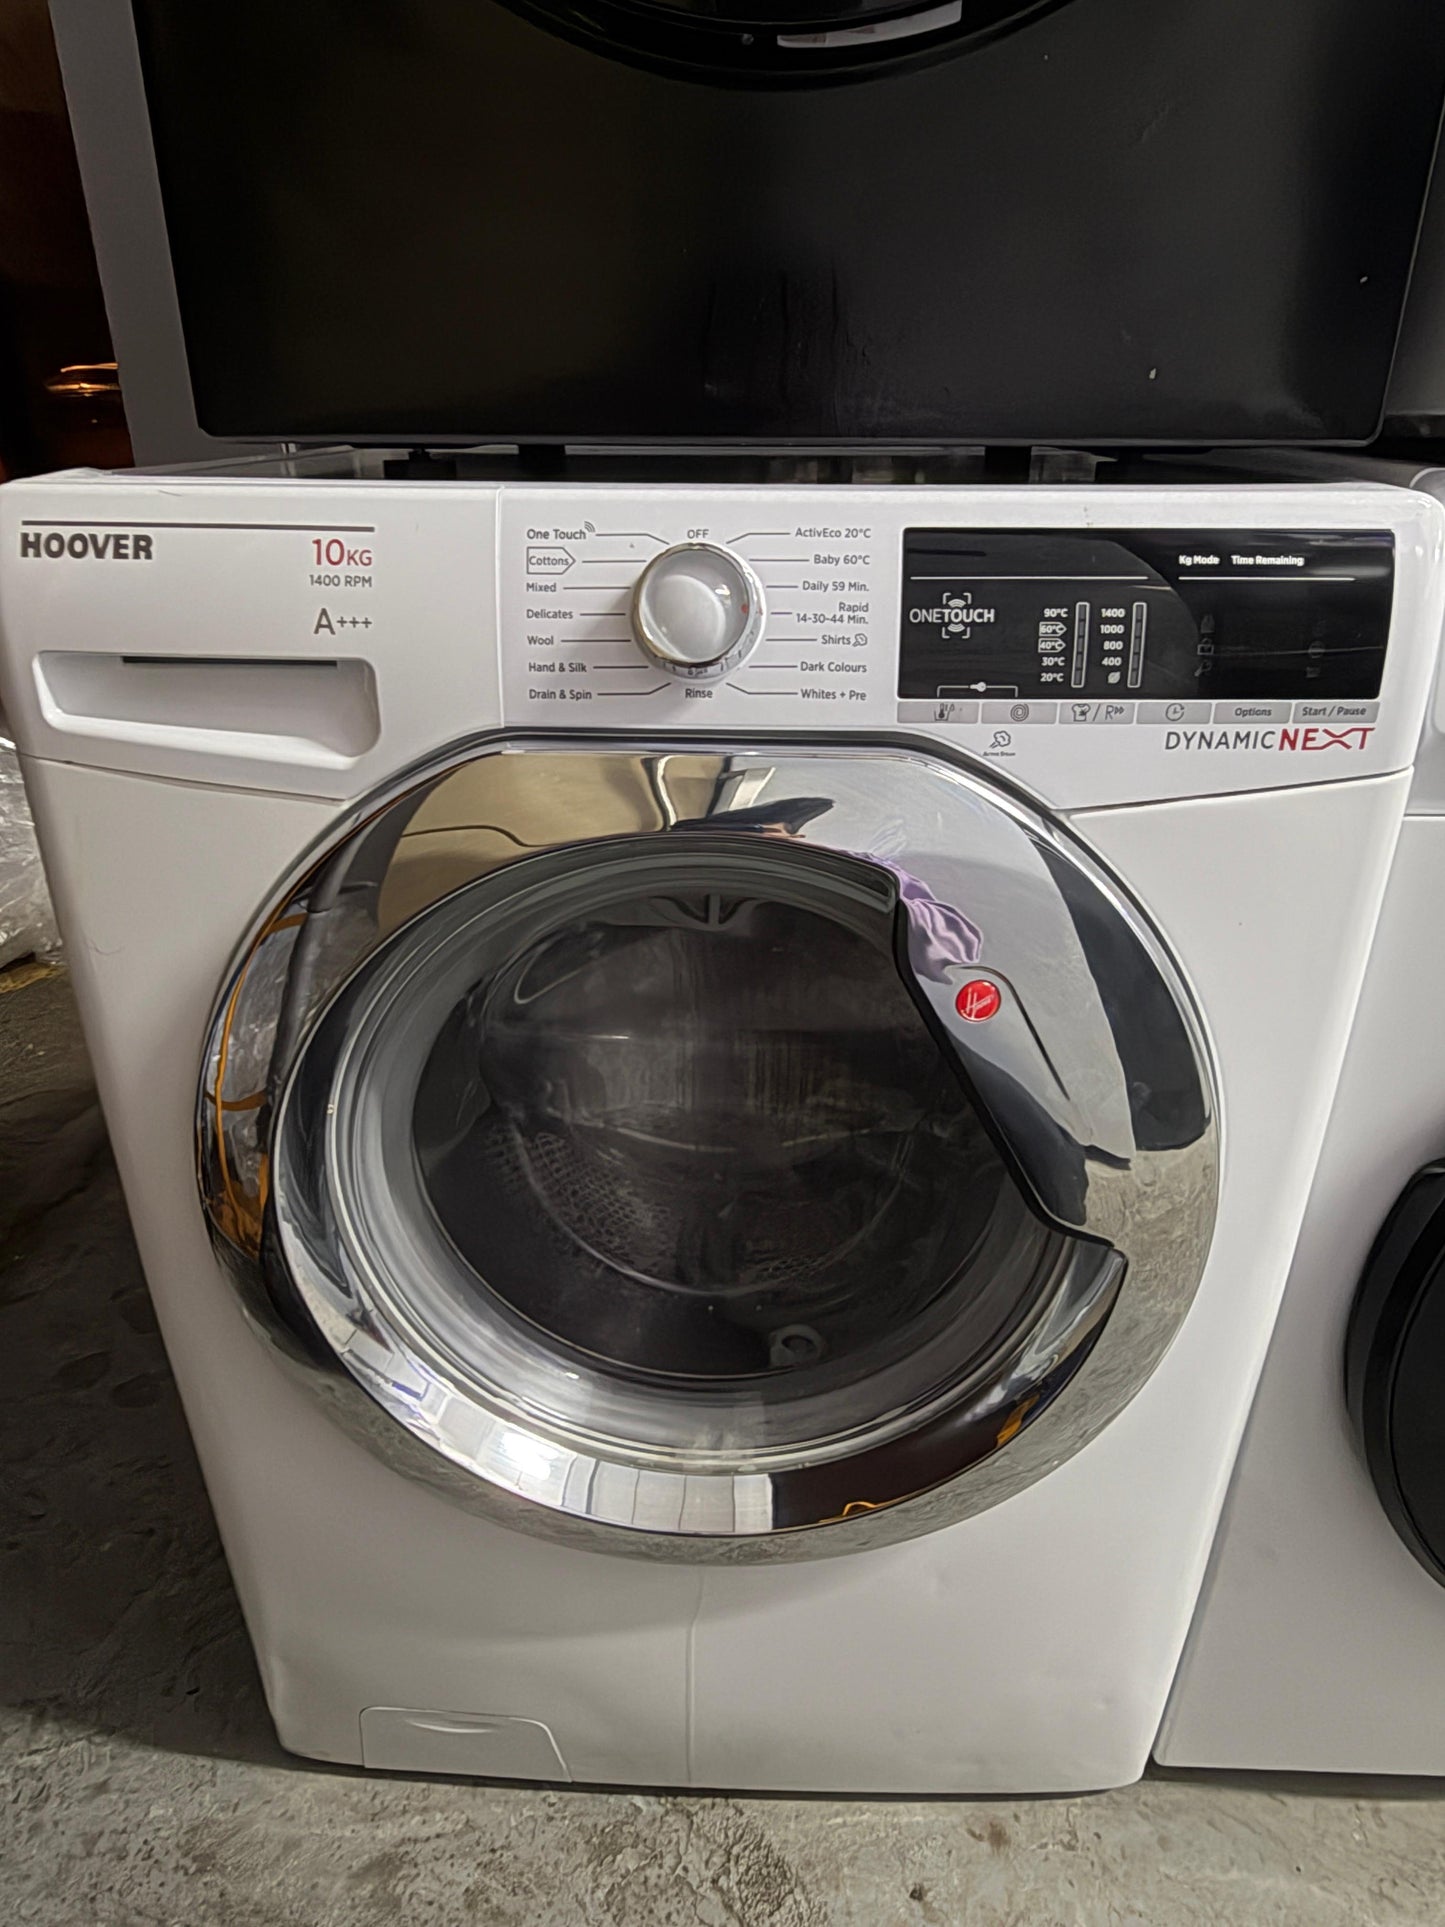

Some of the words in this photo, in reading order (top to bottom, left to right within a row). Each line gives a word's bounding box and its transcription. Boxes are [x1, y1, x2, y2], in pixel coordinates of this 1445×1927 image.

[527, 529, 550, 540] One
[553, 529, 586, 540] Touch
[687, 529, 709, 539] OFF
[795, 528, 842, 538] ActivEco
[844, 529, 871, 538] 20°C
[20, 532, 153, 560] HOOVER
[312, 538, 373, 566] 10KG
[529, 555, 569, 566] Cottons
[814, 554, 840, 566] Baby
[843, 555, 870, 565] 60°C
[1179, 555, 1192, 566] Kg
[1193, 555, 1220, 565] Mode
[1231, 555, 1254, 565] Time
[1255, 555, 1304, 567] Remaining
[309, 574, 341, 587] 1400
[344, 575, 372, 588] RPM
[802, 581, 829, 592] Daily
[832, 582, 845, 591] 59
[848, 582, 870, 592] Min.
[526, 583, 557, 592] Mixed
[838, 602, 869, 613] Rapid
[1043, 608, 1068, 617] 90°C
[1101, 608, 1125, 617] 1400
[526, 609, 574, 619] Delicates
[796, 613, 845, 624] 14-30-44
[847, 614, 869, 624] Min.
[313, 608, 372, 635] A+++
[1100, 624, 1124, 634] 1000
[527, 635, 554, 645] Wool
[821, 634, 851, 645] Shirts
[1103, 641, 1123, 650] 800
[528, 662, 555, 672] Hand
[558, 662, 566, 672] &
[568, 662, 587, 672] Silk
[1041, 657, 1065, 666] 30°C
[1101, 657, 1122, 666] 400
[800, 662, 825, 671] Dark
[828, 662, 867, 673] Colours
[1040, 673, 1064, 682] 20°C
[529, 689, 556, 699] Drain
[559, 689, 566, 699] &
[569, 689, 592, 700] Spin
[685, 688, 713, 698] Rinse
[801, 689, 836, 699] Whites
[849, 690, 867, 700] Pre
[1234, 708, 1272, 719] Options
[1302, 707, 1326, 717] Start
[1337, 707, 1367, 717] Pause
[1165, 731, 1276, 751] DYNAMIC
